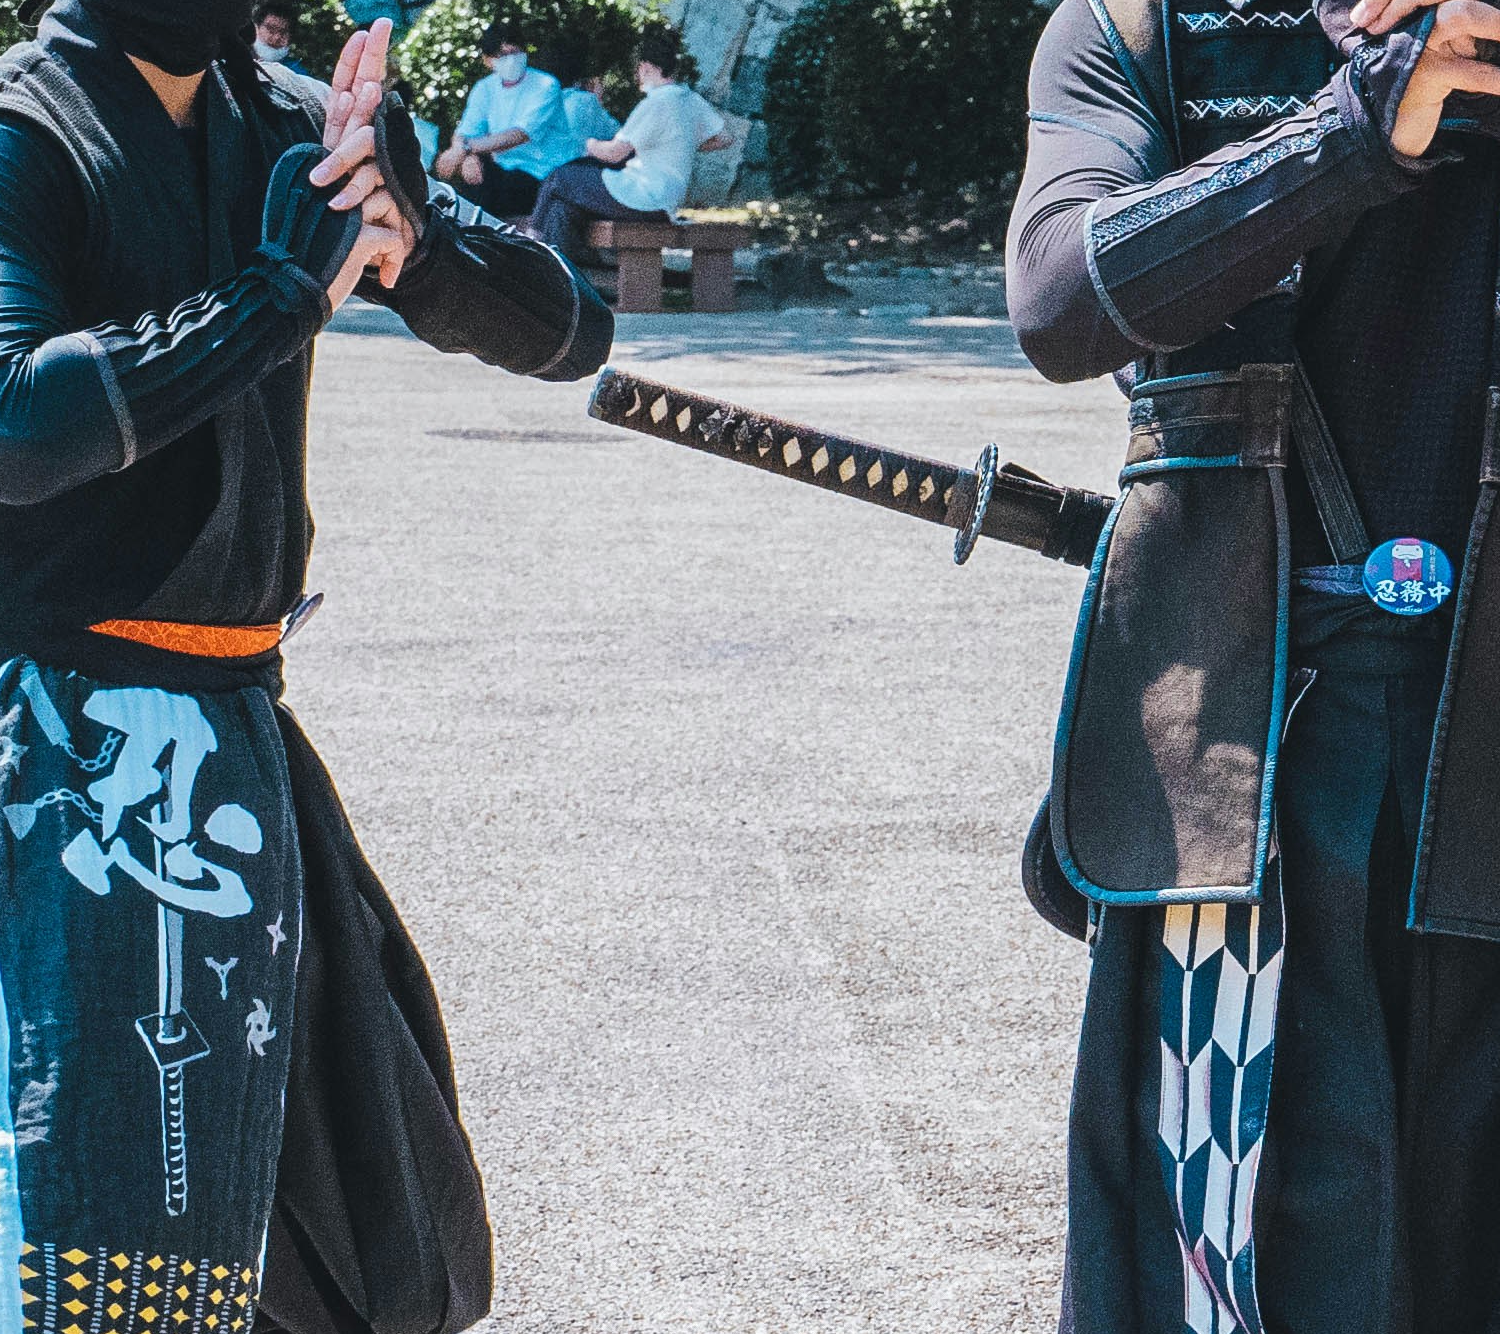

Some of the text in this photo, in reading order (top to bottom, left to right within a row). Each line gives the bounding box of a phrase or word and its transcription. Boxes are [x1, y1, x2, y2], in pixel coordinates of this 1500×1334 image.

[1373, 579, 1452, 605] 忍務中
[63, 688, 262, 918] 忍
